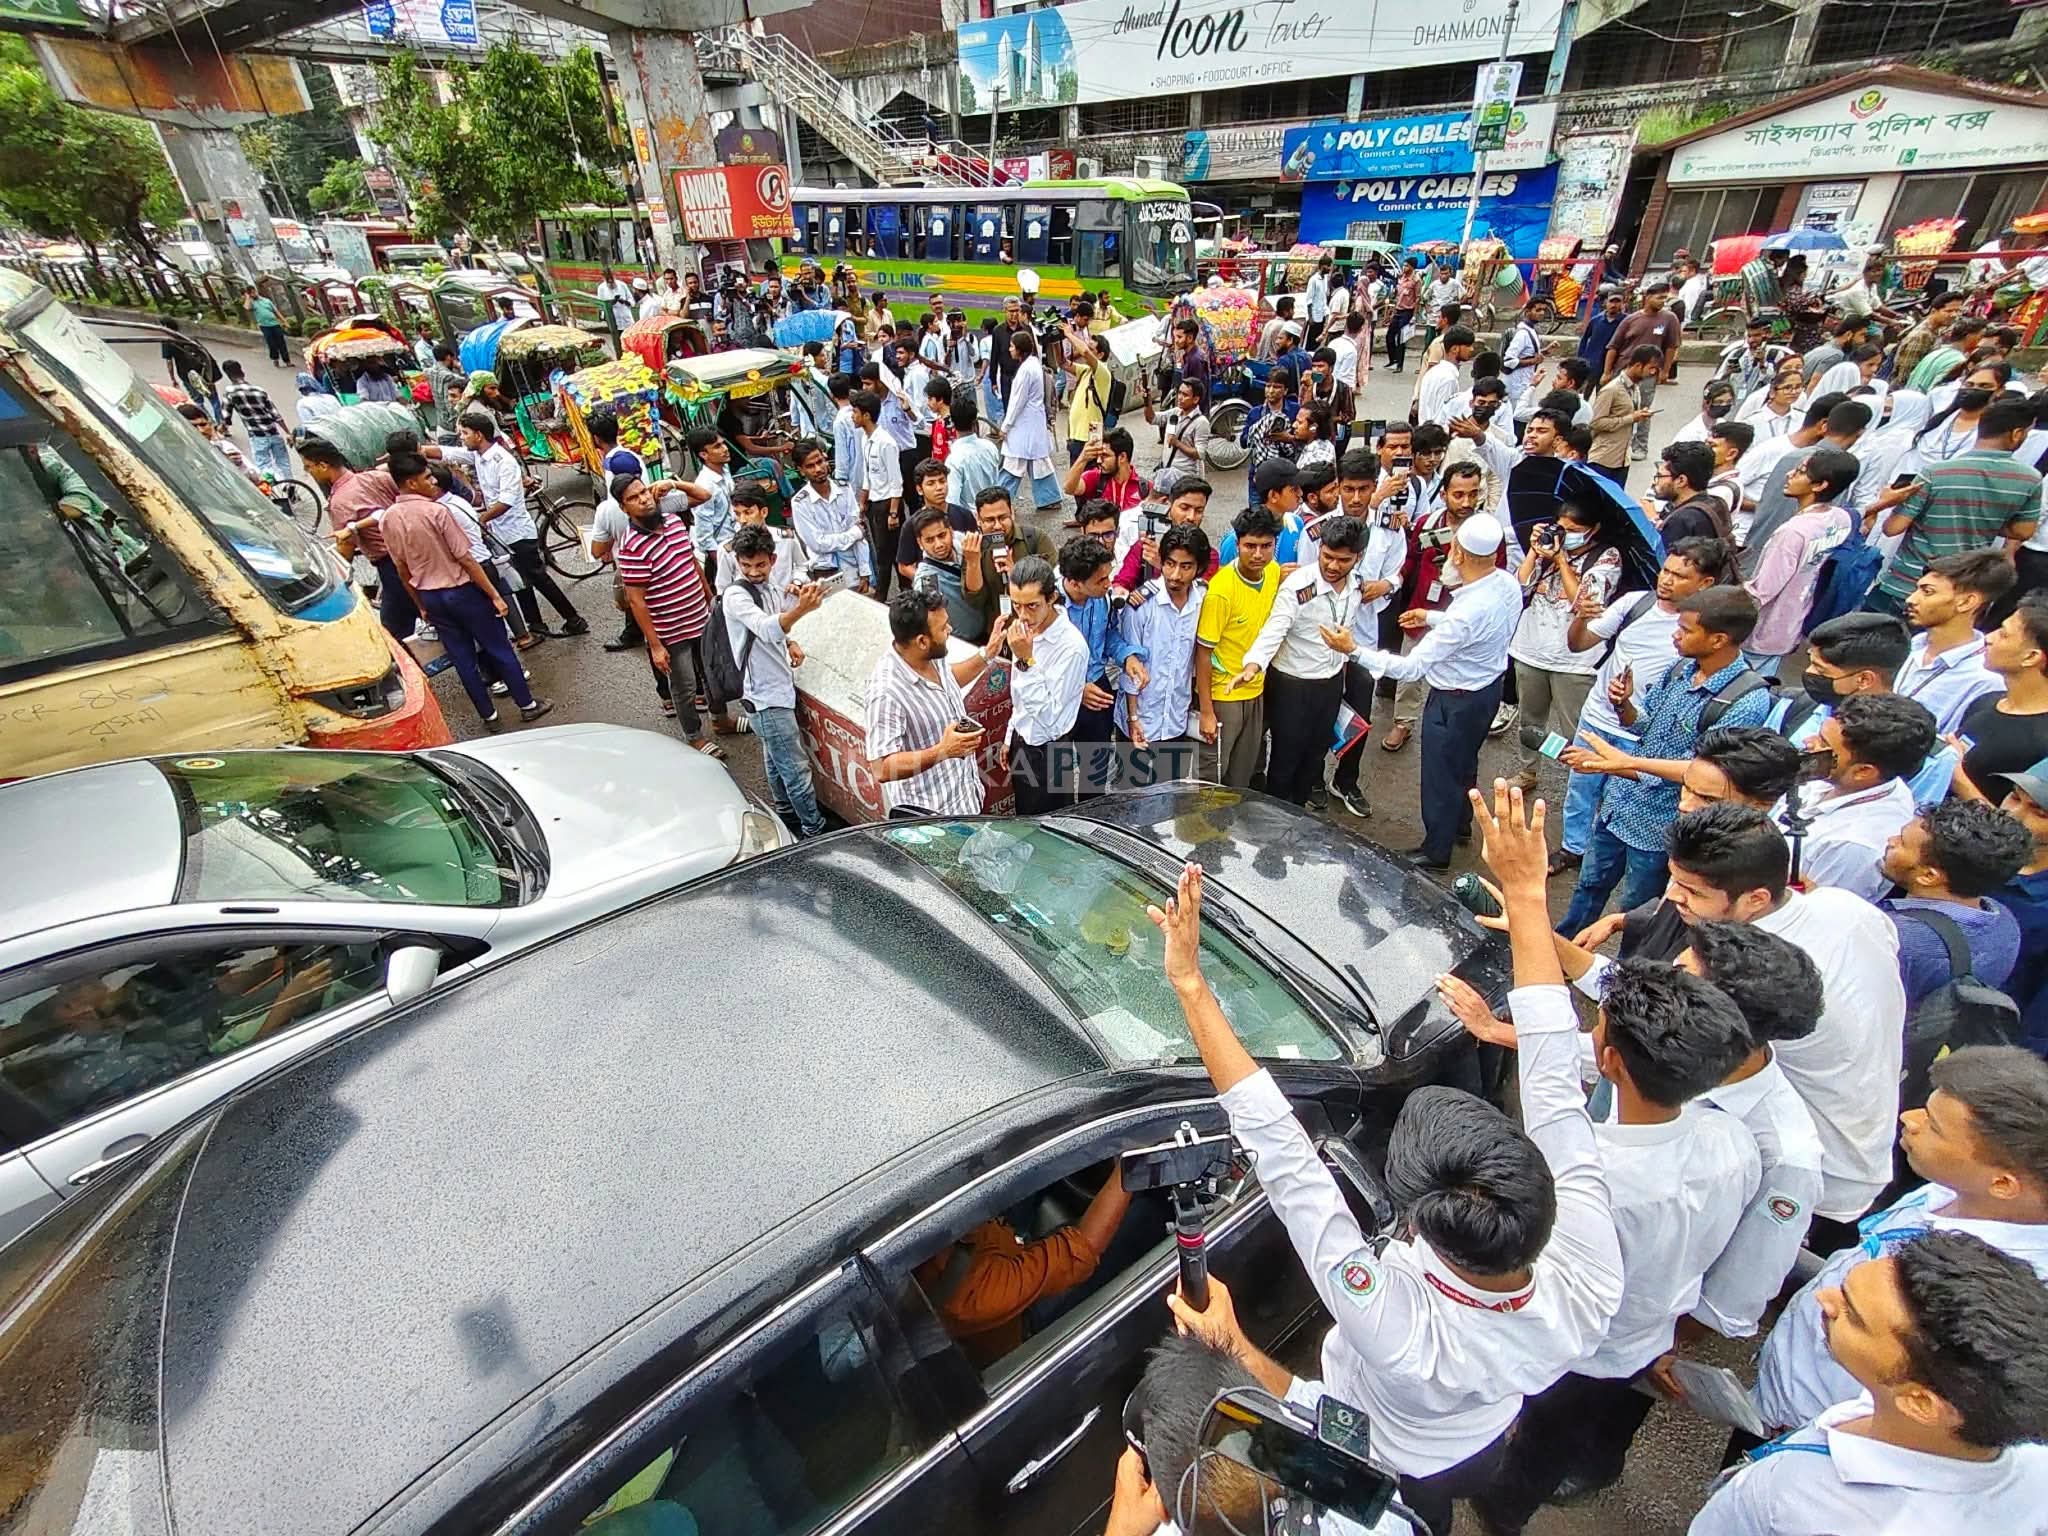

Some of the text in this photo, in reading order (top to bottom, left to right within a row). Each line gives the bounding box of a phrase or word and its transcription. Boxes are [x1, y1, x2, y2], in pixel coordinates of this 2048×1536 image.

[1113, 0, 1333, 61] Ahmed Icon Tower
[1155, 60, 1294, 89] SHOPPING FOODCOURT OFFICE
[1337, 121, 1472, 151] POLY CABLES
[1865, 112, 1937, 142] পুলিশ
[1945, 110, 1996, 131] বক্স
[1359, 146, 1445, 159] Connect & Protect
[680, 172, 731, 210] ANWAR
[1352, 174, 1518, 203] POLY CABLES
[1378, 200, 1480, 212] Connect & Protet
[685, 208, 735, 239] CEMENT
[877, 272, 925, 288] D.LINK
